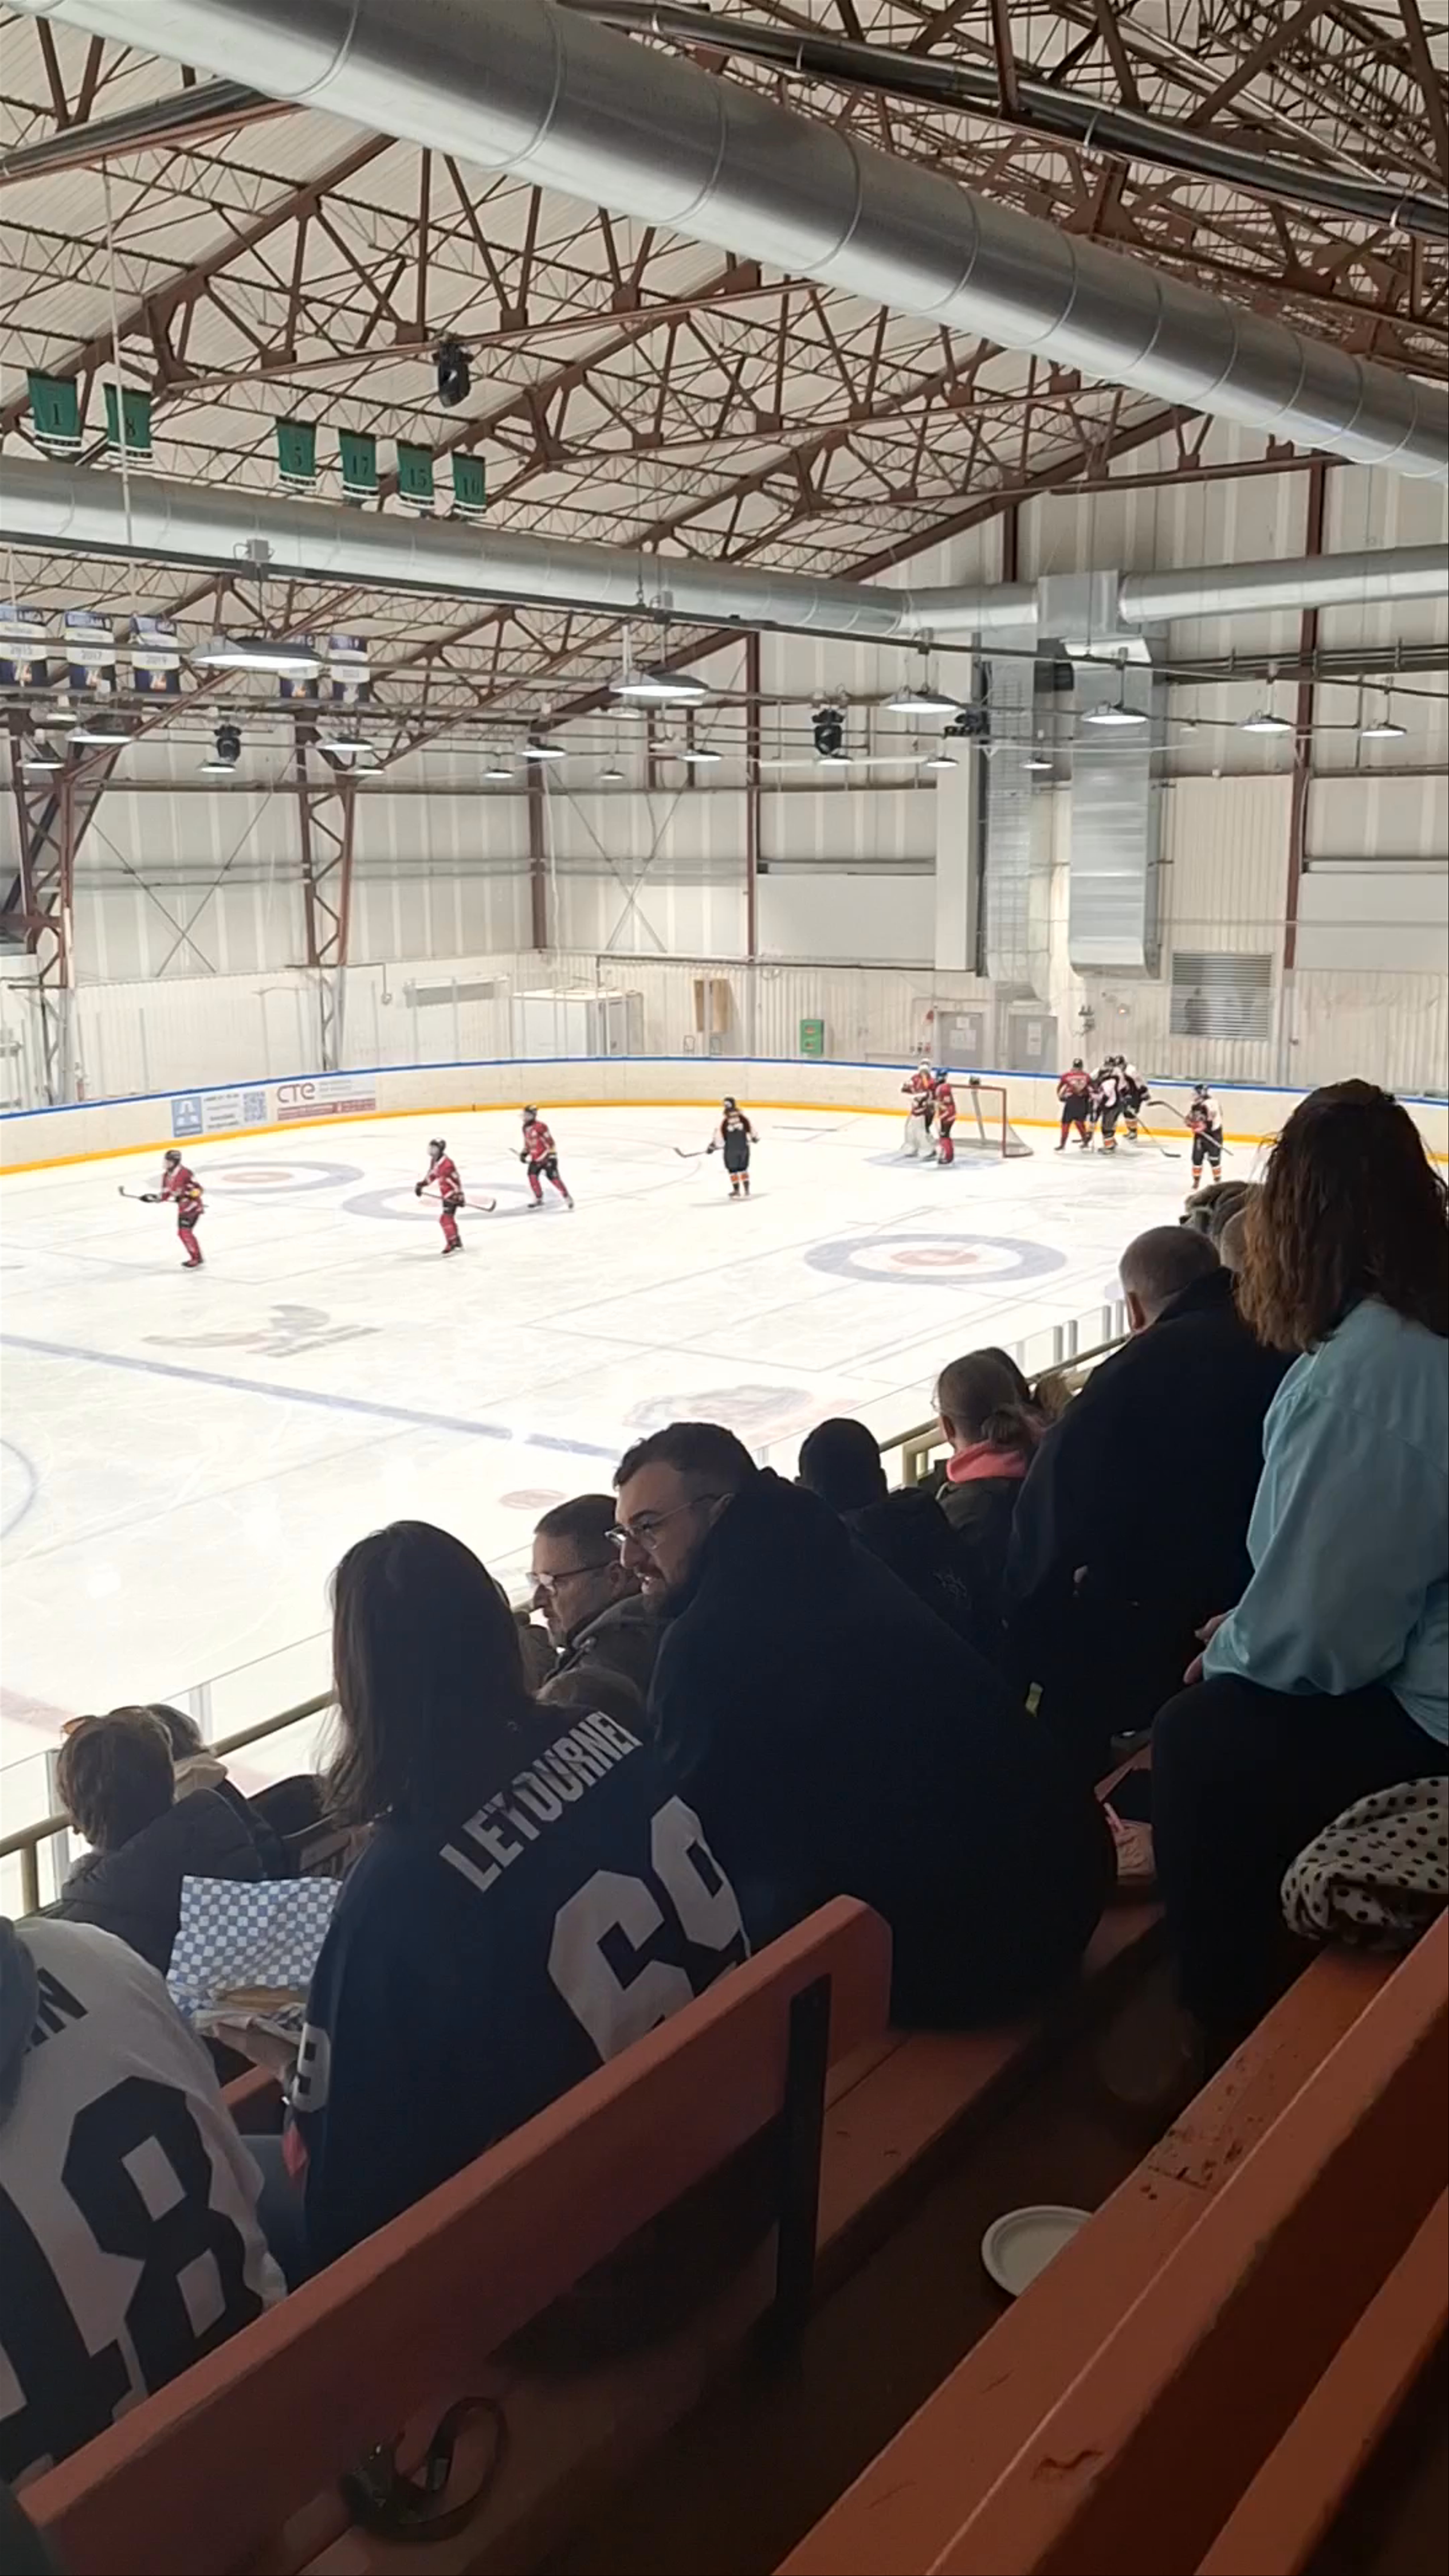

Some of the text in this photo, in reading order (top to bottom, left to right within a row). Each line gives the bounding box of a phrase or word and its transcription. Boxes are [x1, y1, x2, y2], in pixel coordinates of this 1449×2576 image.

[353, 455, 368, 475] 17
[410, 468, 427, 488] 15
[439, 1711, 643, 1893] LETOURNE
[548, 1795, 751, 2065] 69
